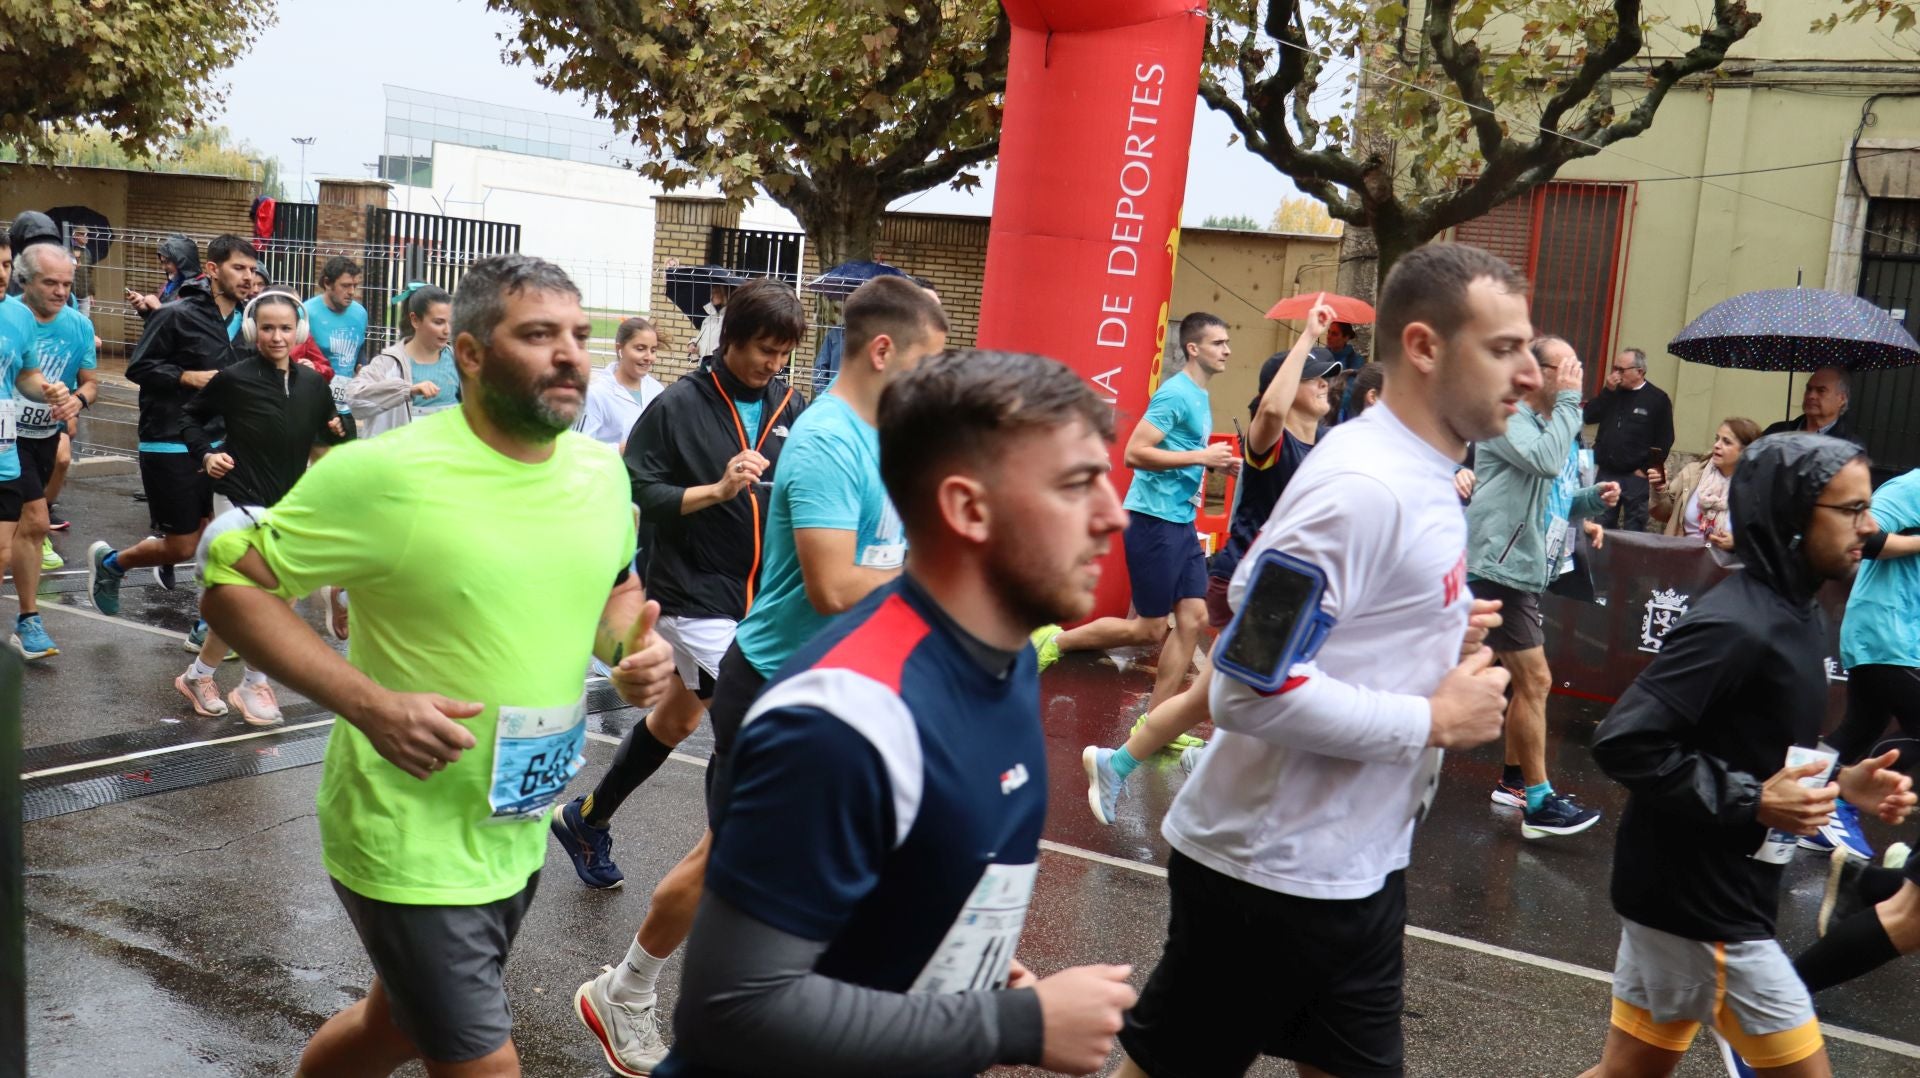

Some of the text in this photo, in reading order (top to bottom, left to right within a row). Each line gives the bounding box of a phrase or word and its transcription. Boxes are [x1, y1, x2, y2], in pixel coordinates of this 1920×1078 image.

[1107, 63, 1165, 277] DEPORTES
[1096, 294, 1132, 348] DE
[20, 406, 52, 425] 884
